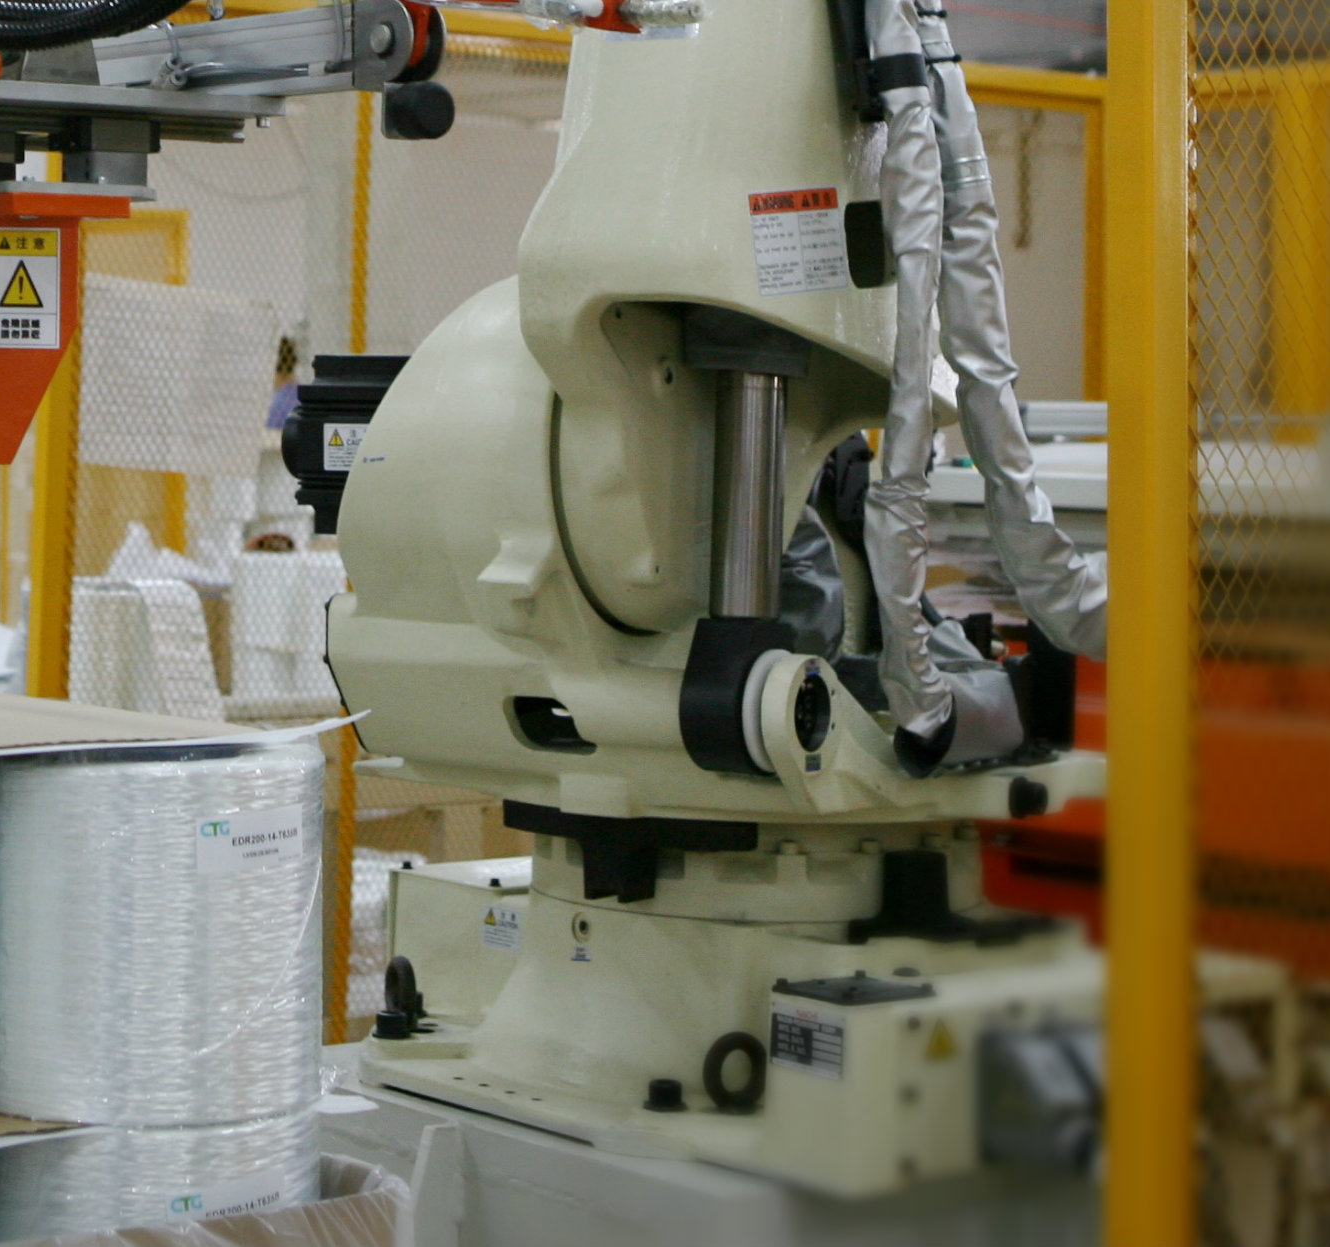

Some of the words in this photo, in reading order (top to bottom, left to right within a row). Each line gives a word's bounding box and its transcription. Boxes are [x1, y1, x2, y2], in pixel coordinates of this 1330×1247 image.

[16, 237, 46, 250] 注意
[200, 820, 231, 838] CTG
[170, 1194, 203, 1213] CTG
